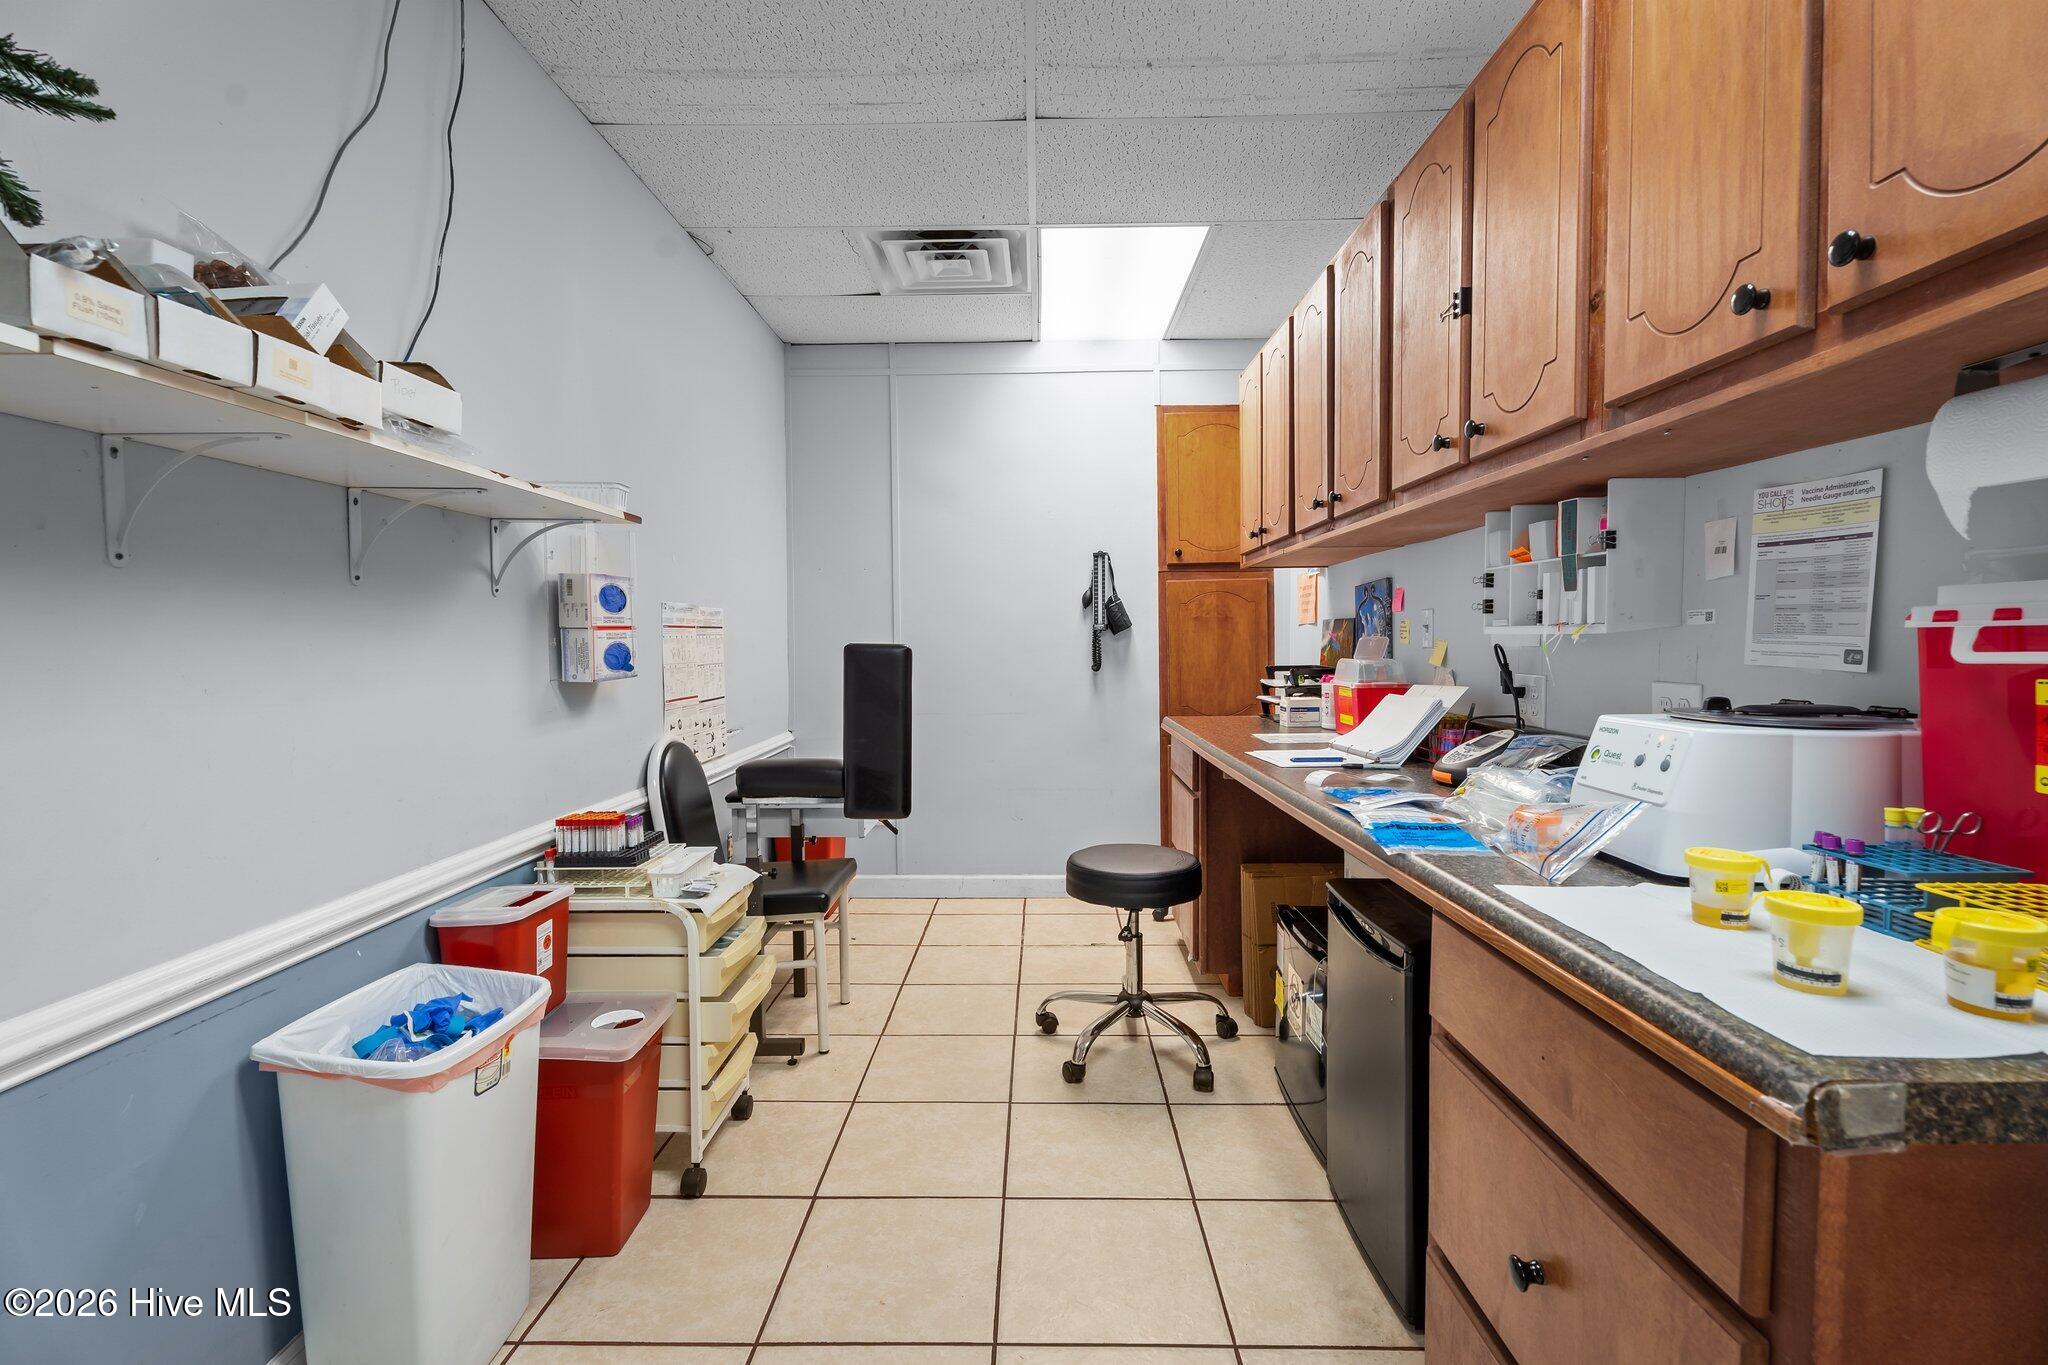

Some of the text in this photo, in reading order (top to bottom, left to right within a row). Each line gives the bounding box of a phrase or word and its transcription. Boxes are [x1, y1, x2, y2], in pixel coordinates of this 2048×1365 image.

[1801, 479, 1870, 496] Vaccine Administration:
[1770, 489, 1783, 498] CALL
[1801, 485, 1876, 503] Needle Gauge and Length
[1599, 726, 1620, 735] HORIZON
[1603, 749, 1623, 760] Quest
